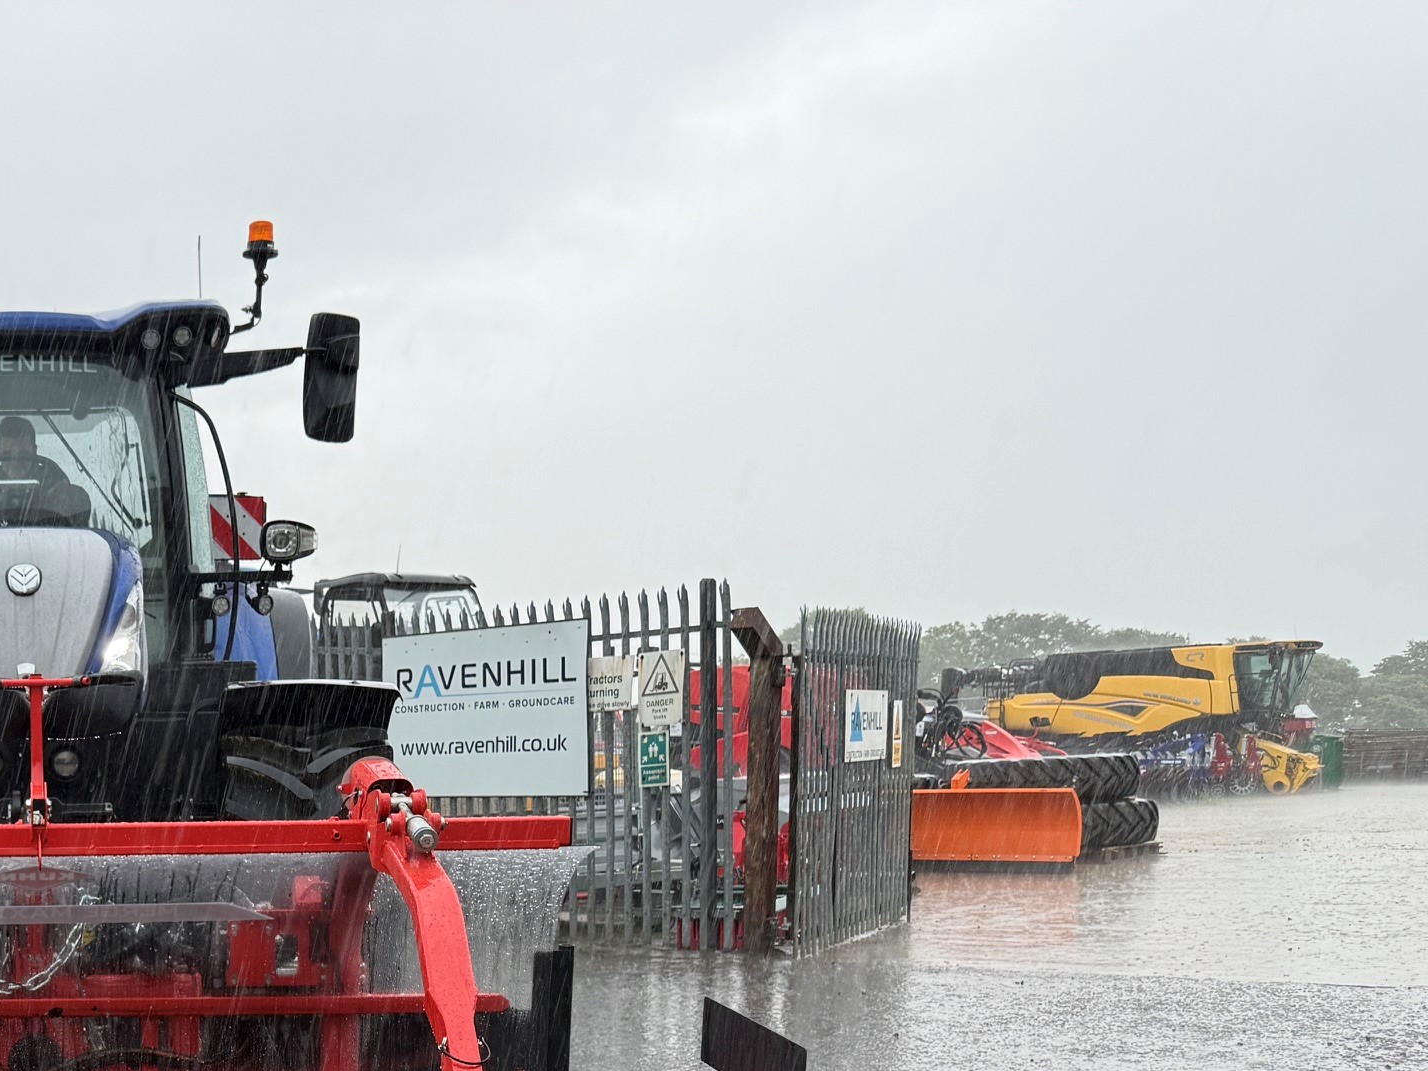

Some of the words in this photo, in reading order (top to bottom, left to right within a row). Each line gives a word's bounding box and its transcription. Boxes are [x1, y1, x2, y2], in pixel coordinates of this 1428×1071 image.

[396, 656, 577, 699] RAVENHILL
[588, 674, 623, 685] ractors
[589, 687, 620, 699] urning
[394, 702, 465, 714] CONSTRUCTION
[474, 700, 500, 710] FARM
[508, 696, 575, 708] GROUNDCARE
[646, 698, 674, 707] DANGER
[401, 733, 568, 756] www.ravenhill.co.uk
